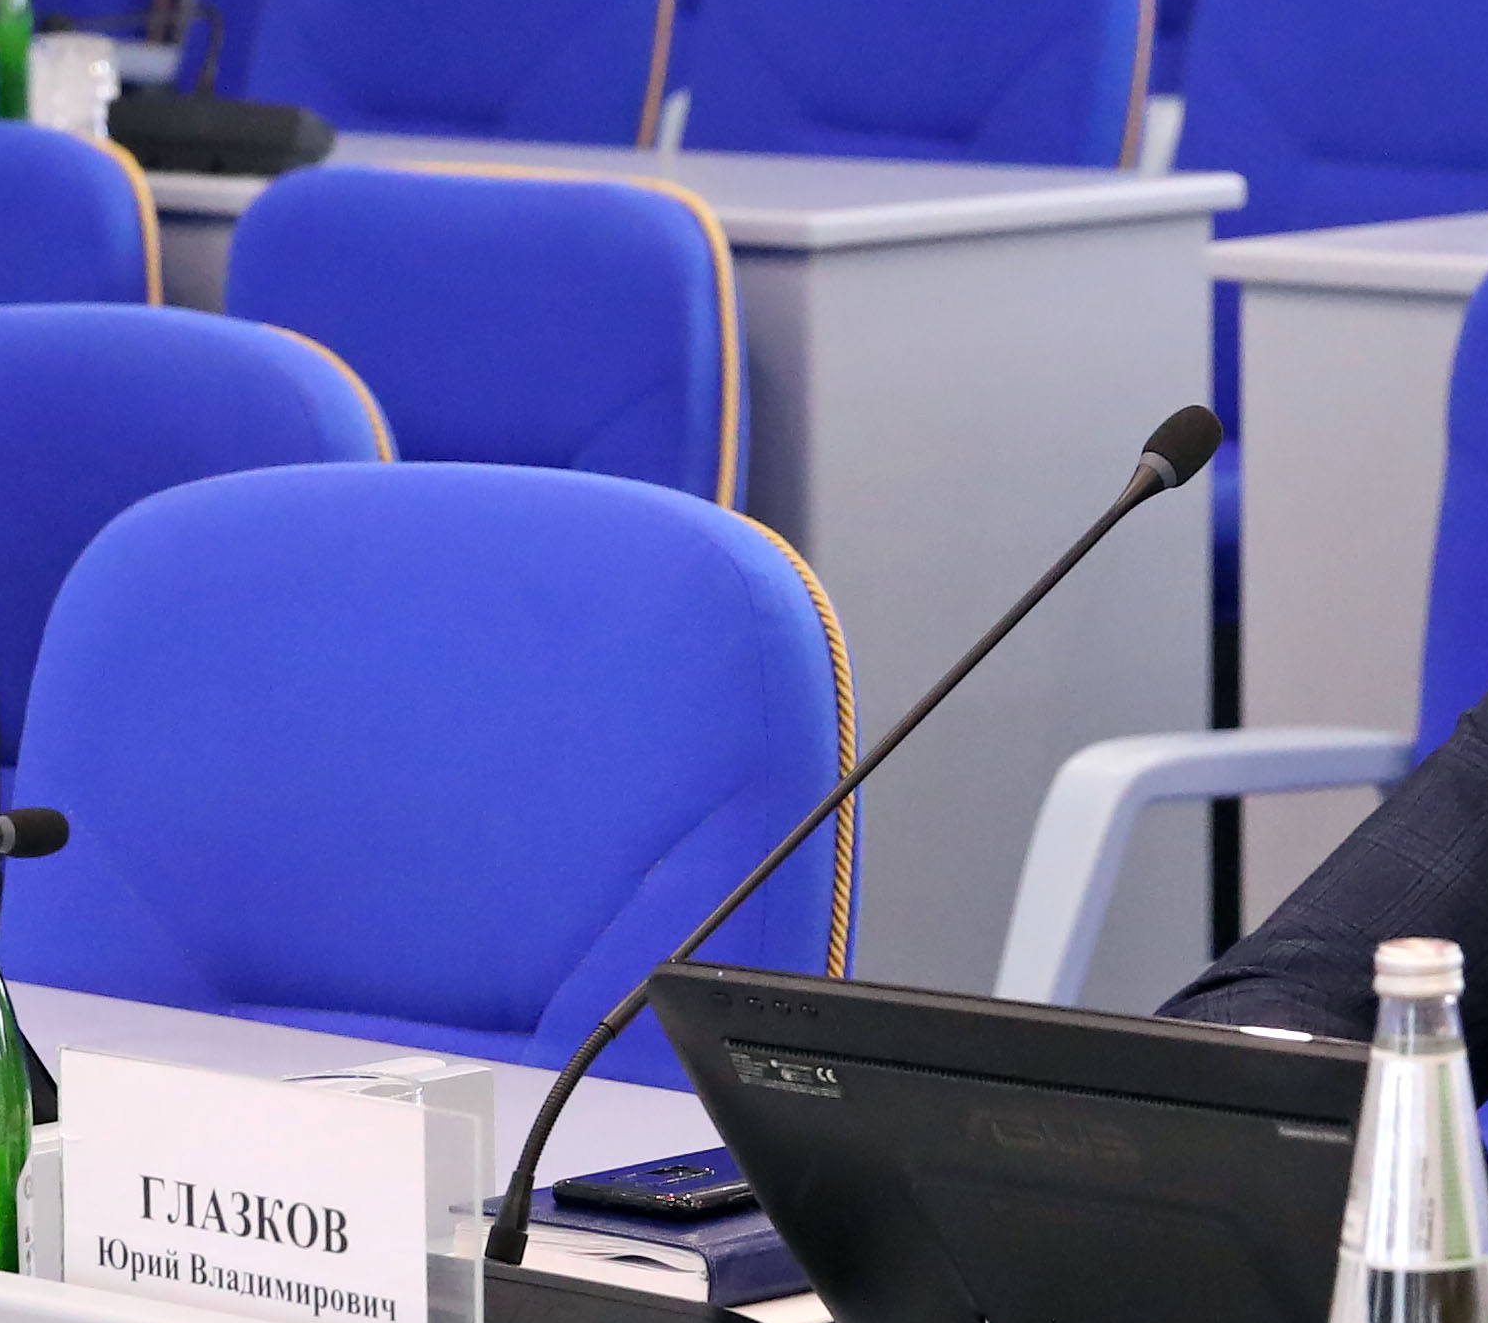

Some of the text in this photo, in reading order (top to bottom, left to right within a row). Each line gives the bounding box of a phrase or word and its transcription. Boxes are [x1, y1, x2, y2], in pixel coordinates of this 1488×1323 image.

[139, 1174, 349, 1254] ГЛАЗКОВ
[96, 1234, 397, 1322] Юрий Владимирович
